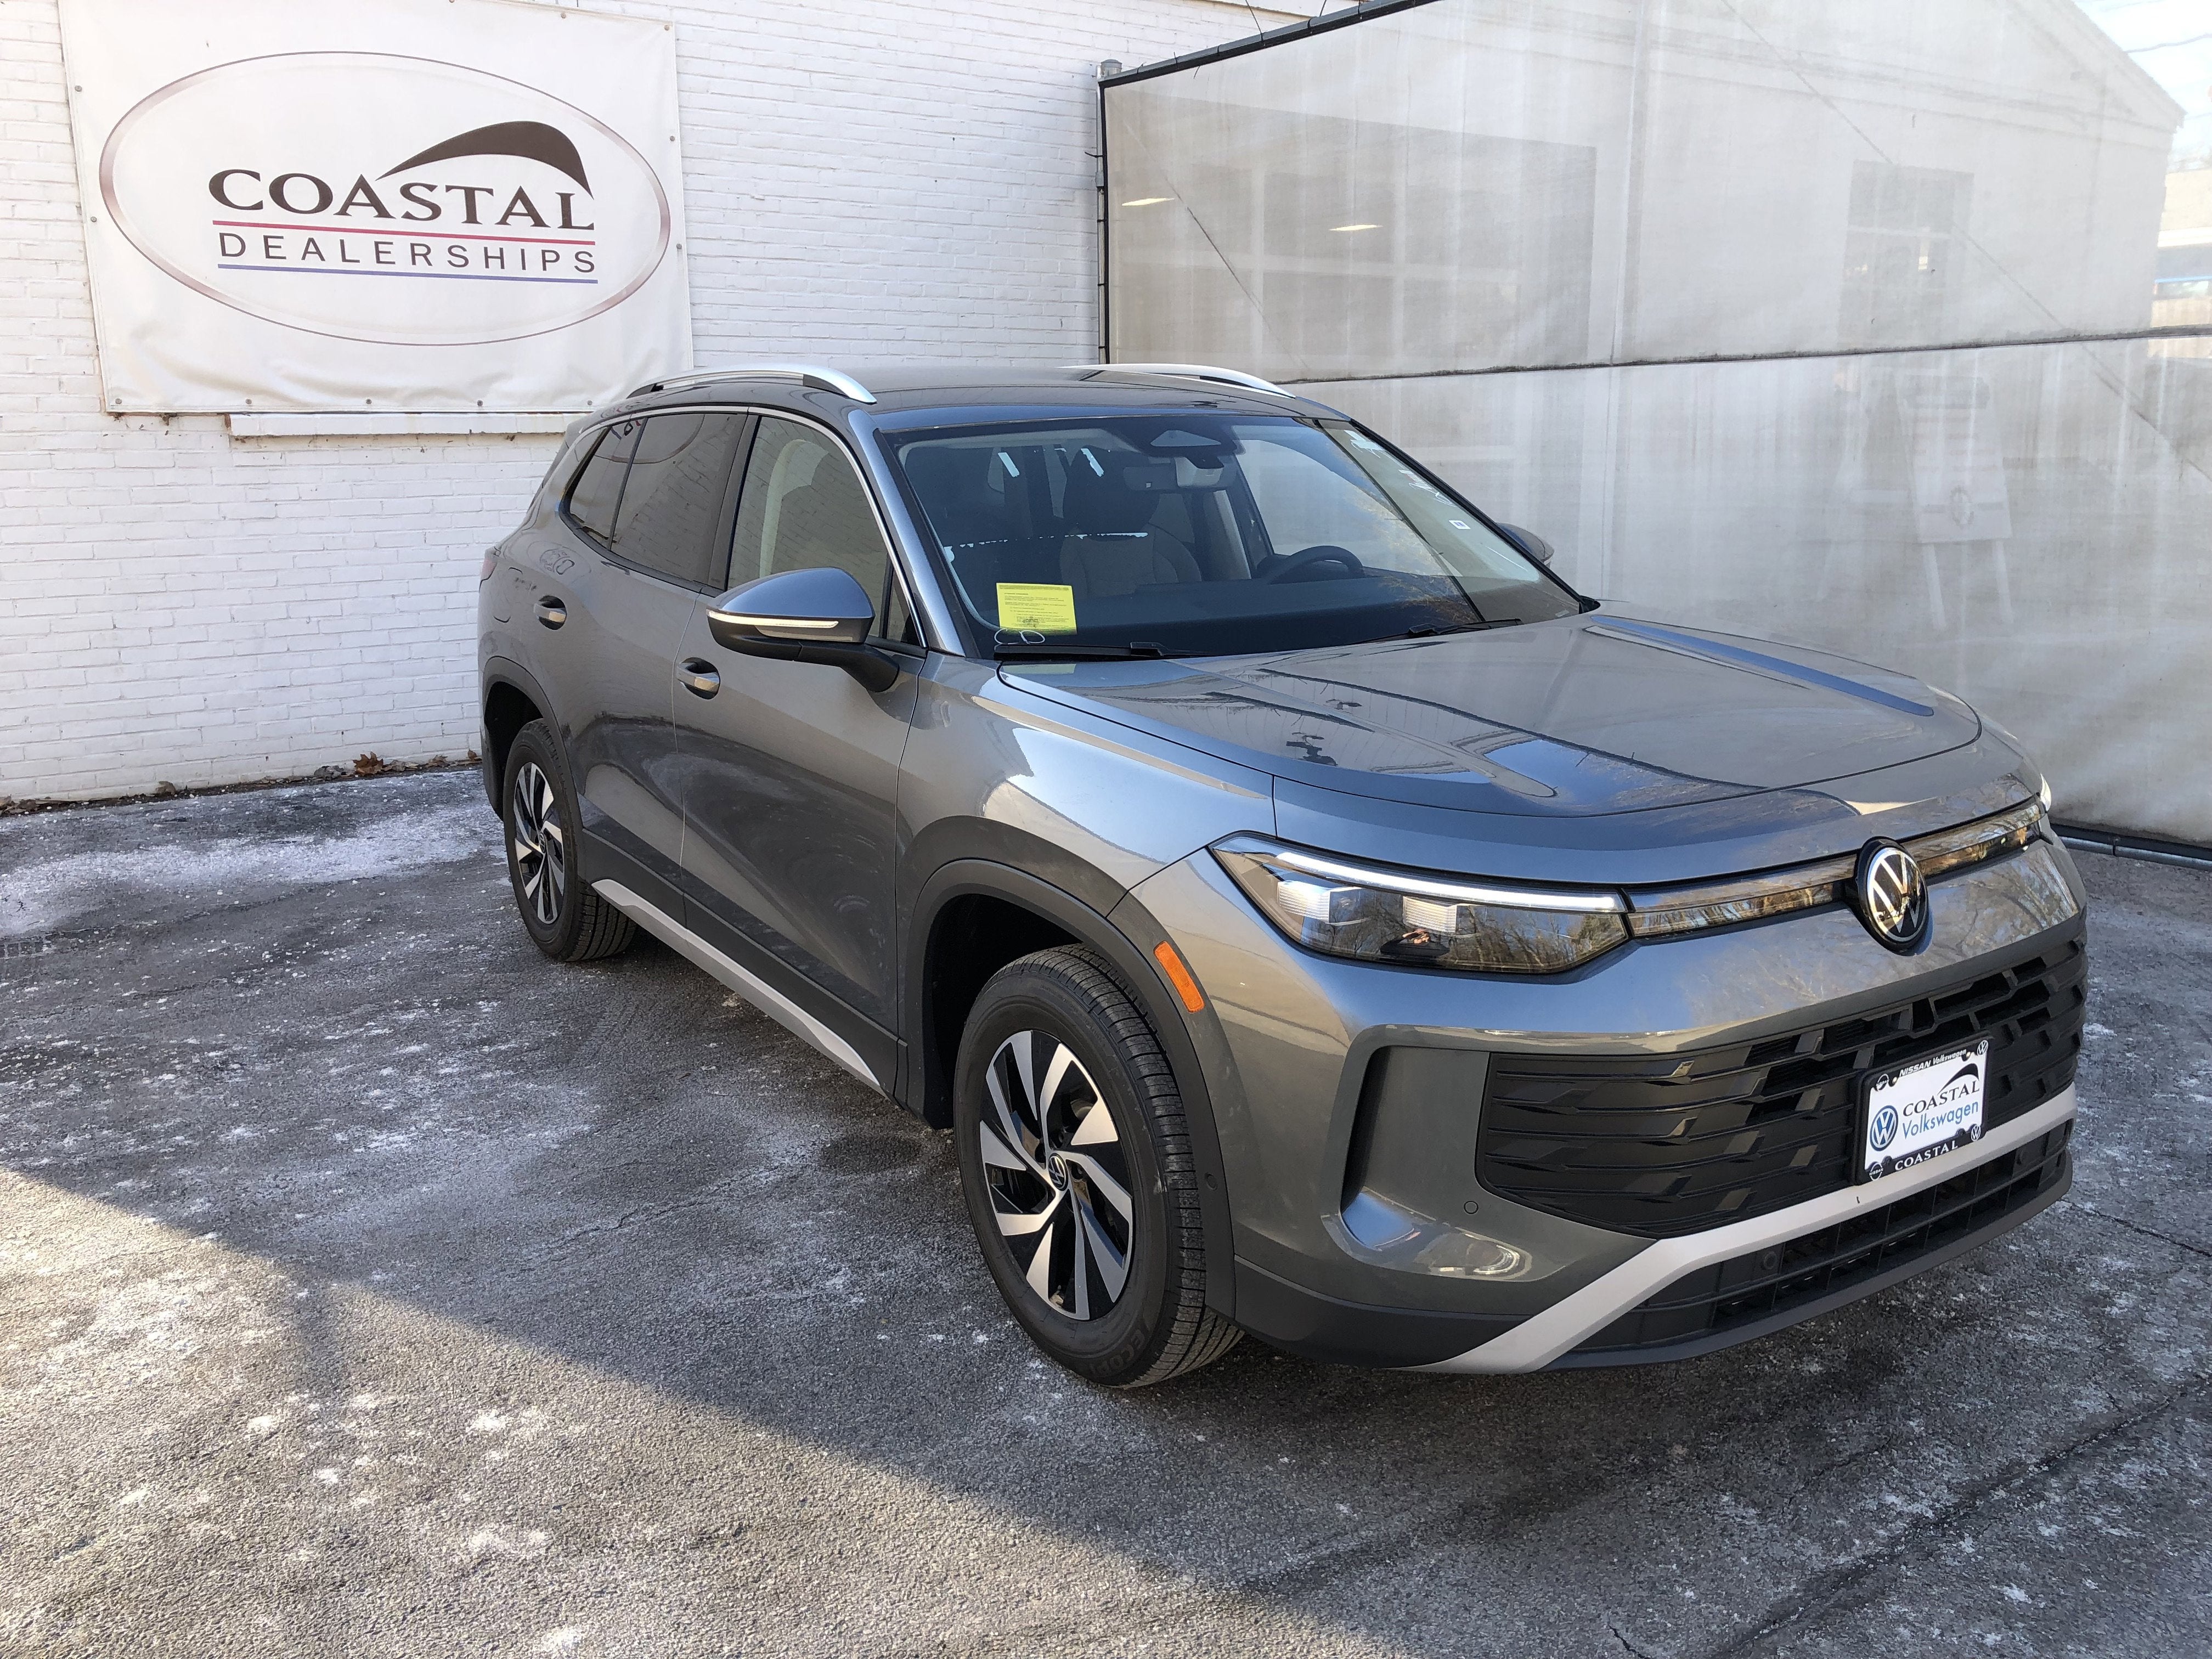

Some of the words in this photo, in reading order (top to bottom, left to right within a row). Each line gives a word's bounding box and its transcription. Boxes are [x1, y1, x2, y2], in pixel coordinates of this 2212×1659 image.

[209, 170, 594, 230] COASTAL
[219, 233, 595, 272] DEALERSHIPS
[1899, 1060, 1931, 1077] NISSAN
[1933, 1049, 1967, 1065] Volkswagen
[1903, 1081, 1980, 1116] COASTAL
[1903, 1101, 1978, 1139] Volkswagen
[1894, 1140, 1958, 1171] COASTAL
